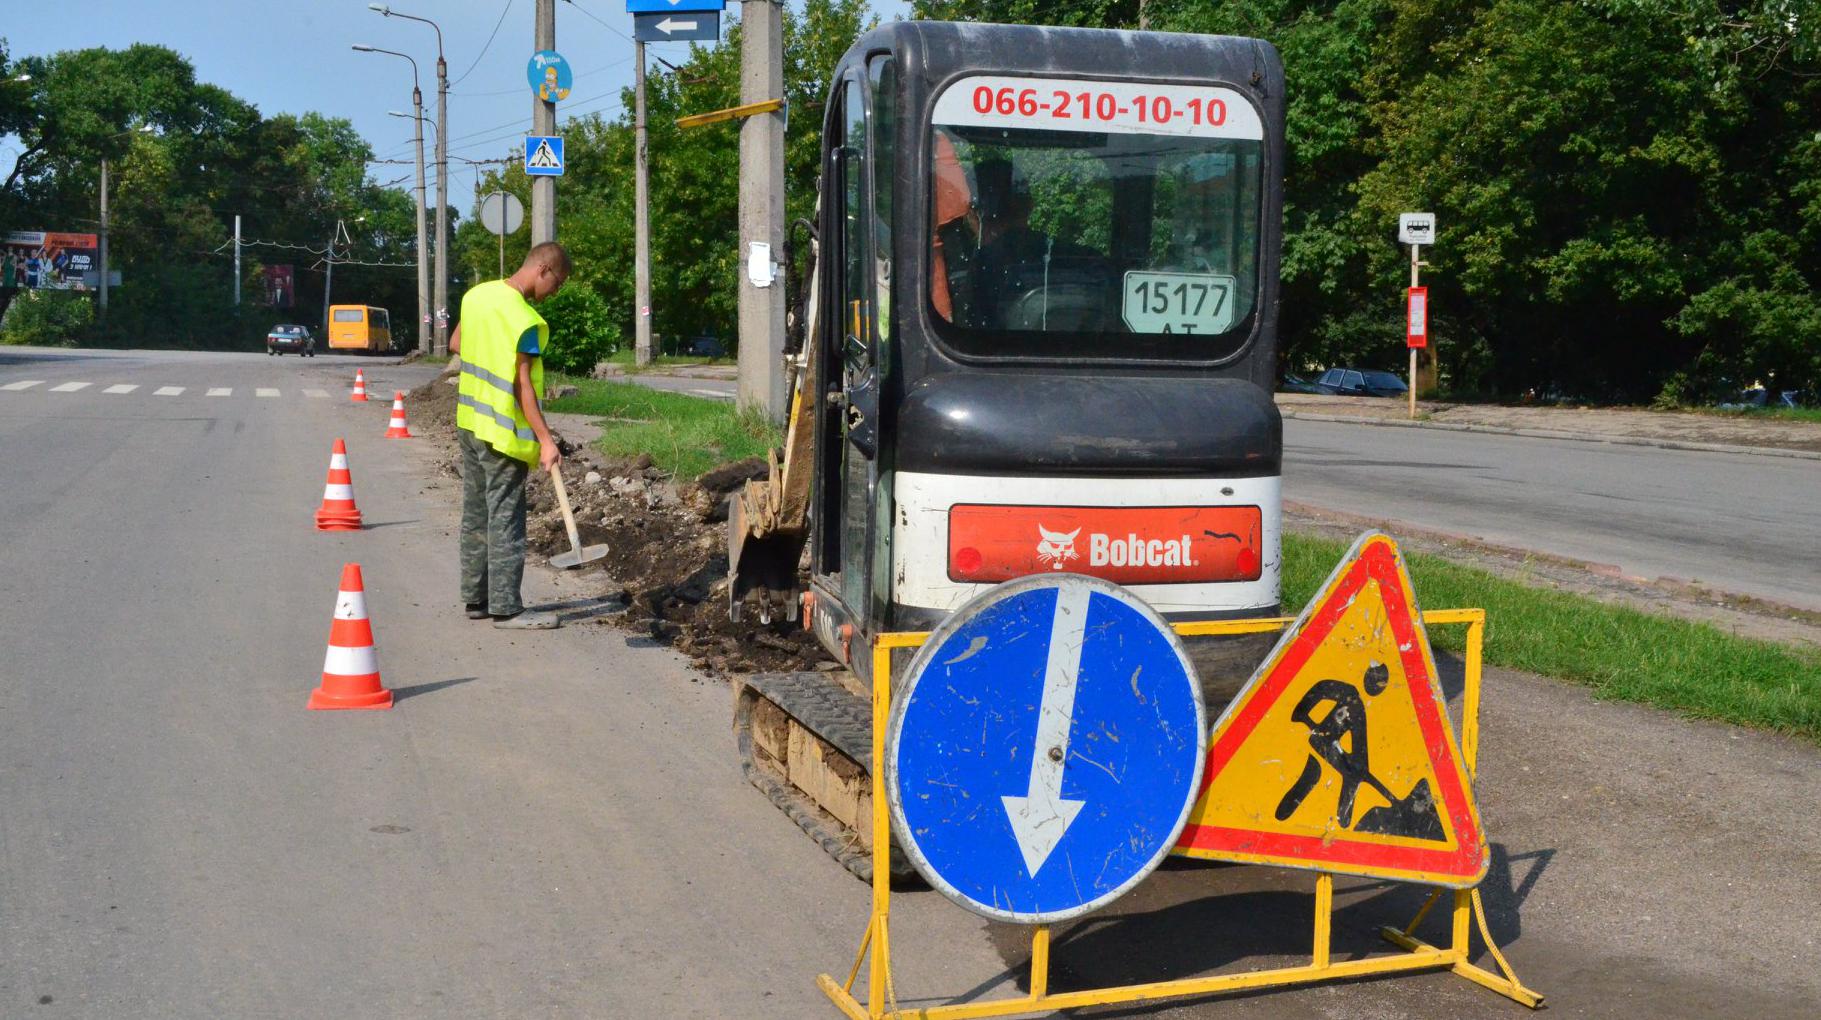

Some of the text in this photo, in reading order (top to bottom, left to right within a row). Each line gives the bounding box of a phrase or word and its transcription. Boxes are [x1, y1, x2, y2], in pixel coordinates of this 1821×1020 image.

[973, 86, 1227, 127] 066-210-10-10
[1134, 281, 1229, 317] 15177
[1090, 533, 1192, 567] Bobcat
